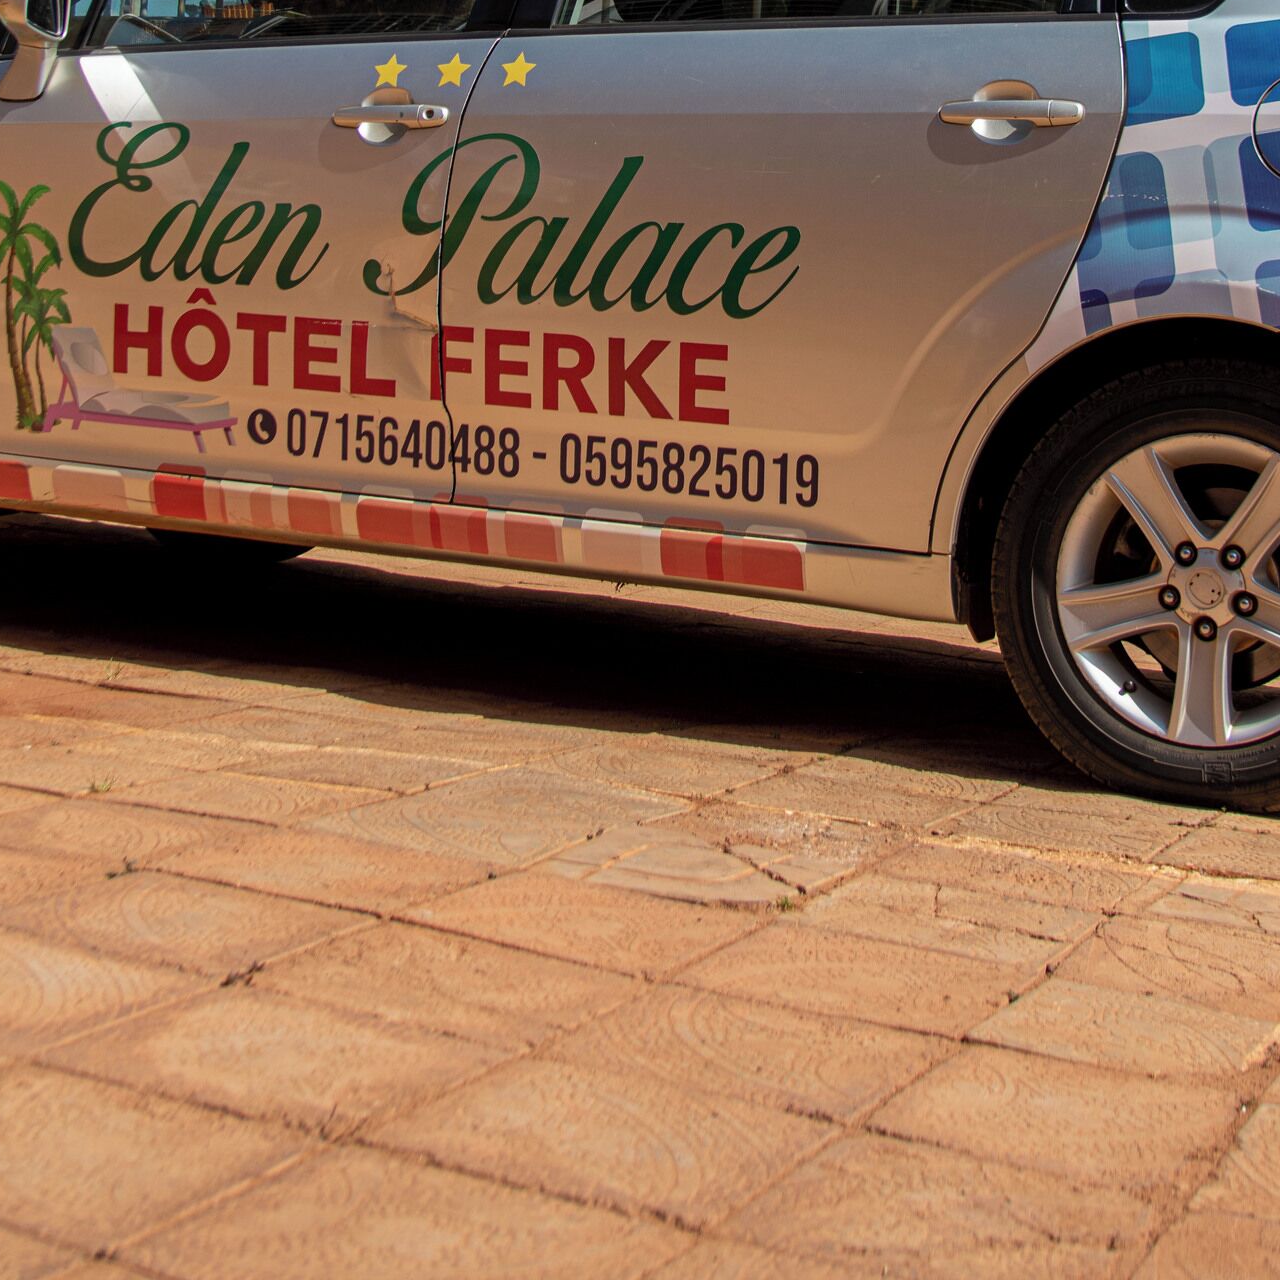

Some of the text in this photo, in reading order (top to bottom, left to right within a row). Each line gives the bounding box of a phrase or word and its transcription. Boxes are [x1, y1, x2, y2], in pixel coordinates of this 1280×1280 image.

[68, 121, 801, 319] Eden Palace
[113, 287, 730, 425] HÔTEL FERKE
[287, 408, 520, 477] 0715640488
[560, 433, 819, 508] 0595825019
